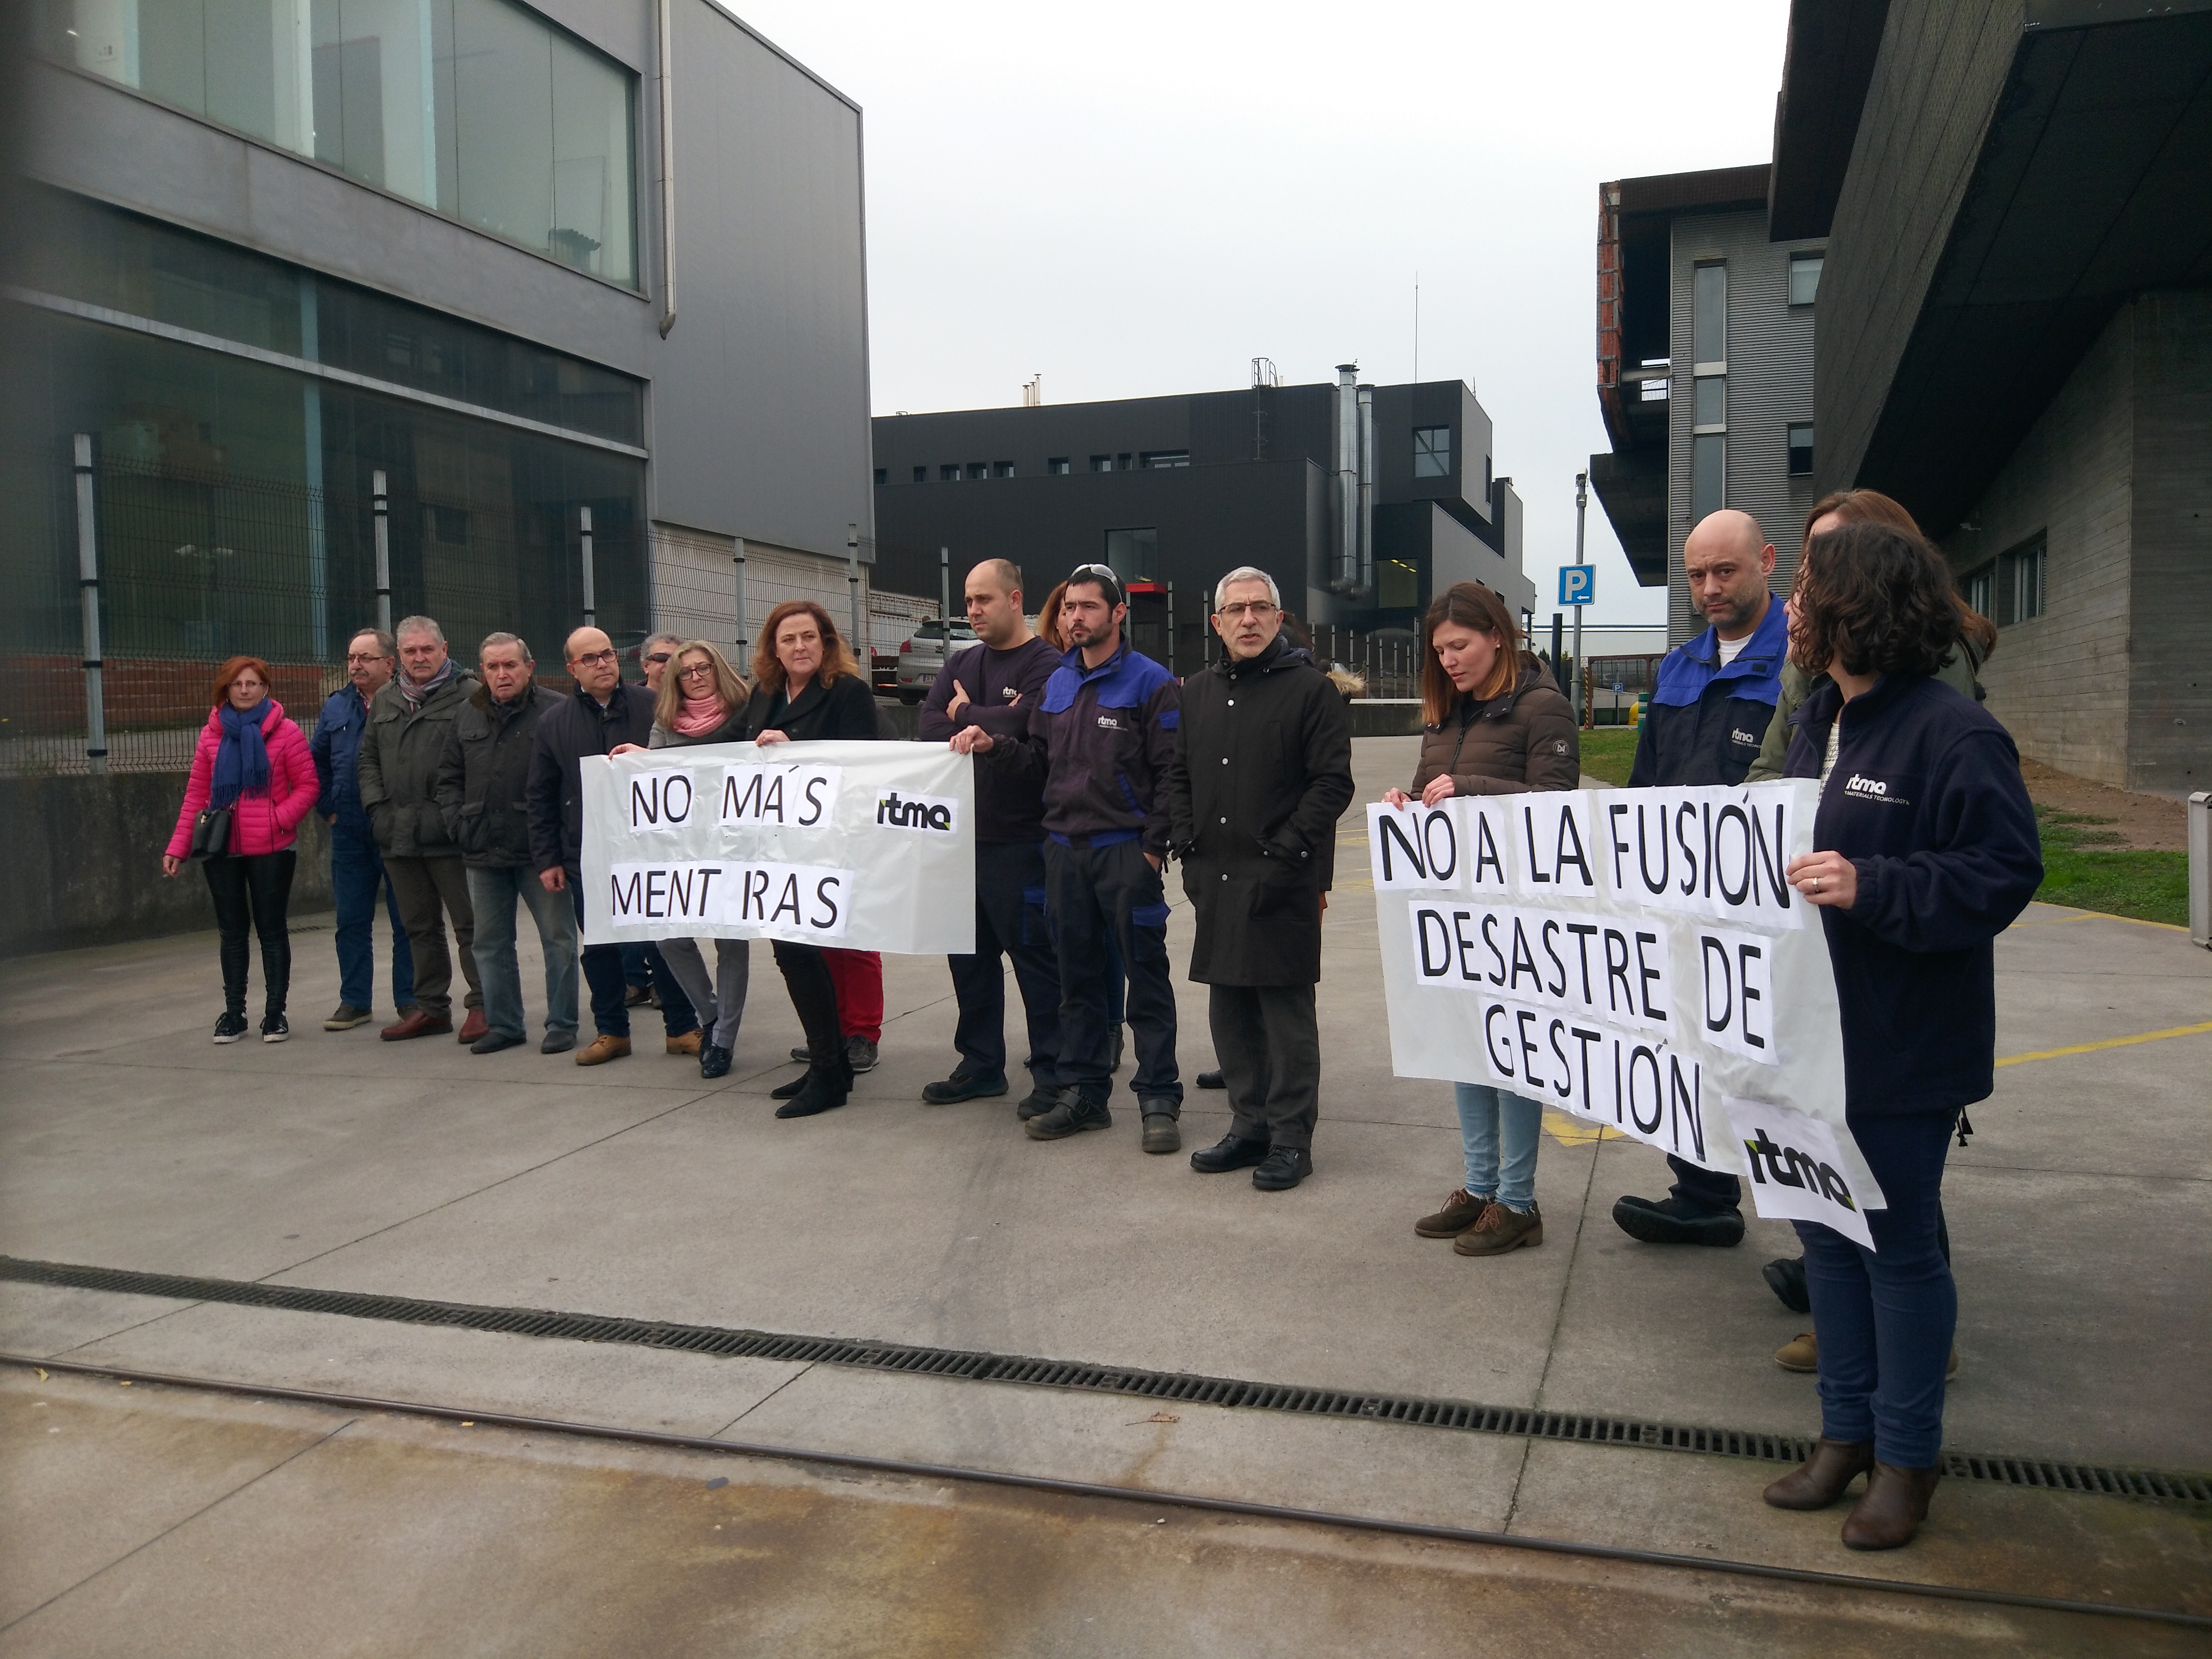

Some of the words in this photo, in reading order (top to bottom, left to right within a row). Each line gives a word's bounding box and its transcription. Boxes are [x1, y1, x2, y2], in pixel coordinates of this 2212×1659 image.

[1565, 570, 1587, 601] P
[633, 774, 692, 827] NO
[723, 765, 827, 826] MÁS
[1847, 791, 1873, 799] MATERIALS
[1379, 810, 1456, 881] NO
[1476, 811, 1504, 884] A
[1525, 805, 1593, 886] LA
[1609, 791, 1790, 909] FUSIÓN
[1417, 909, 1667, 1021] DESASTRE
[1701, 936, 1765, 1049] DE
[1485, 1004, 1706, 1161] GESTIÓN
